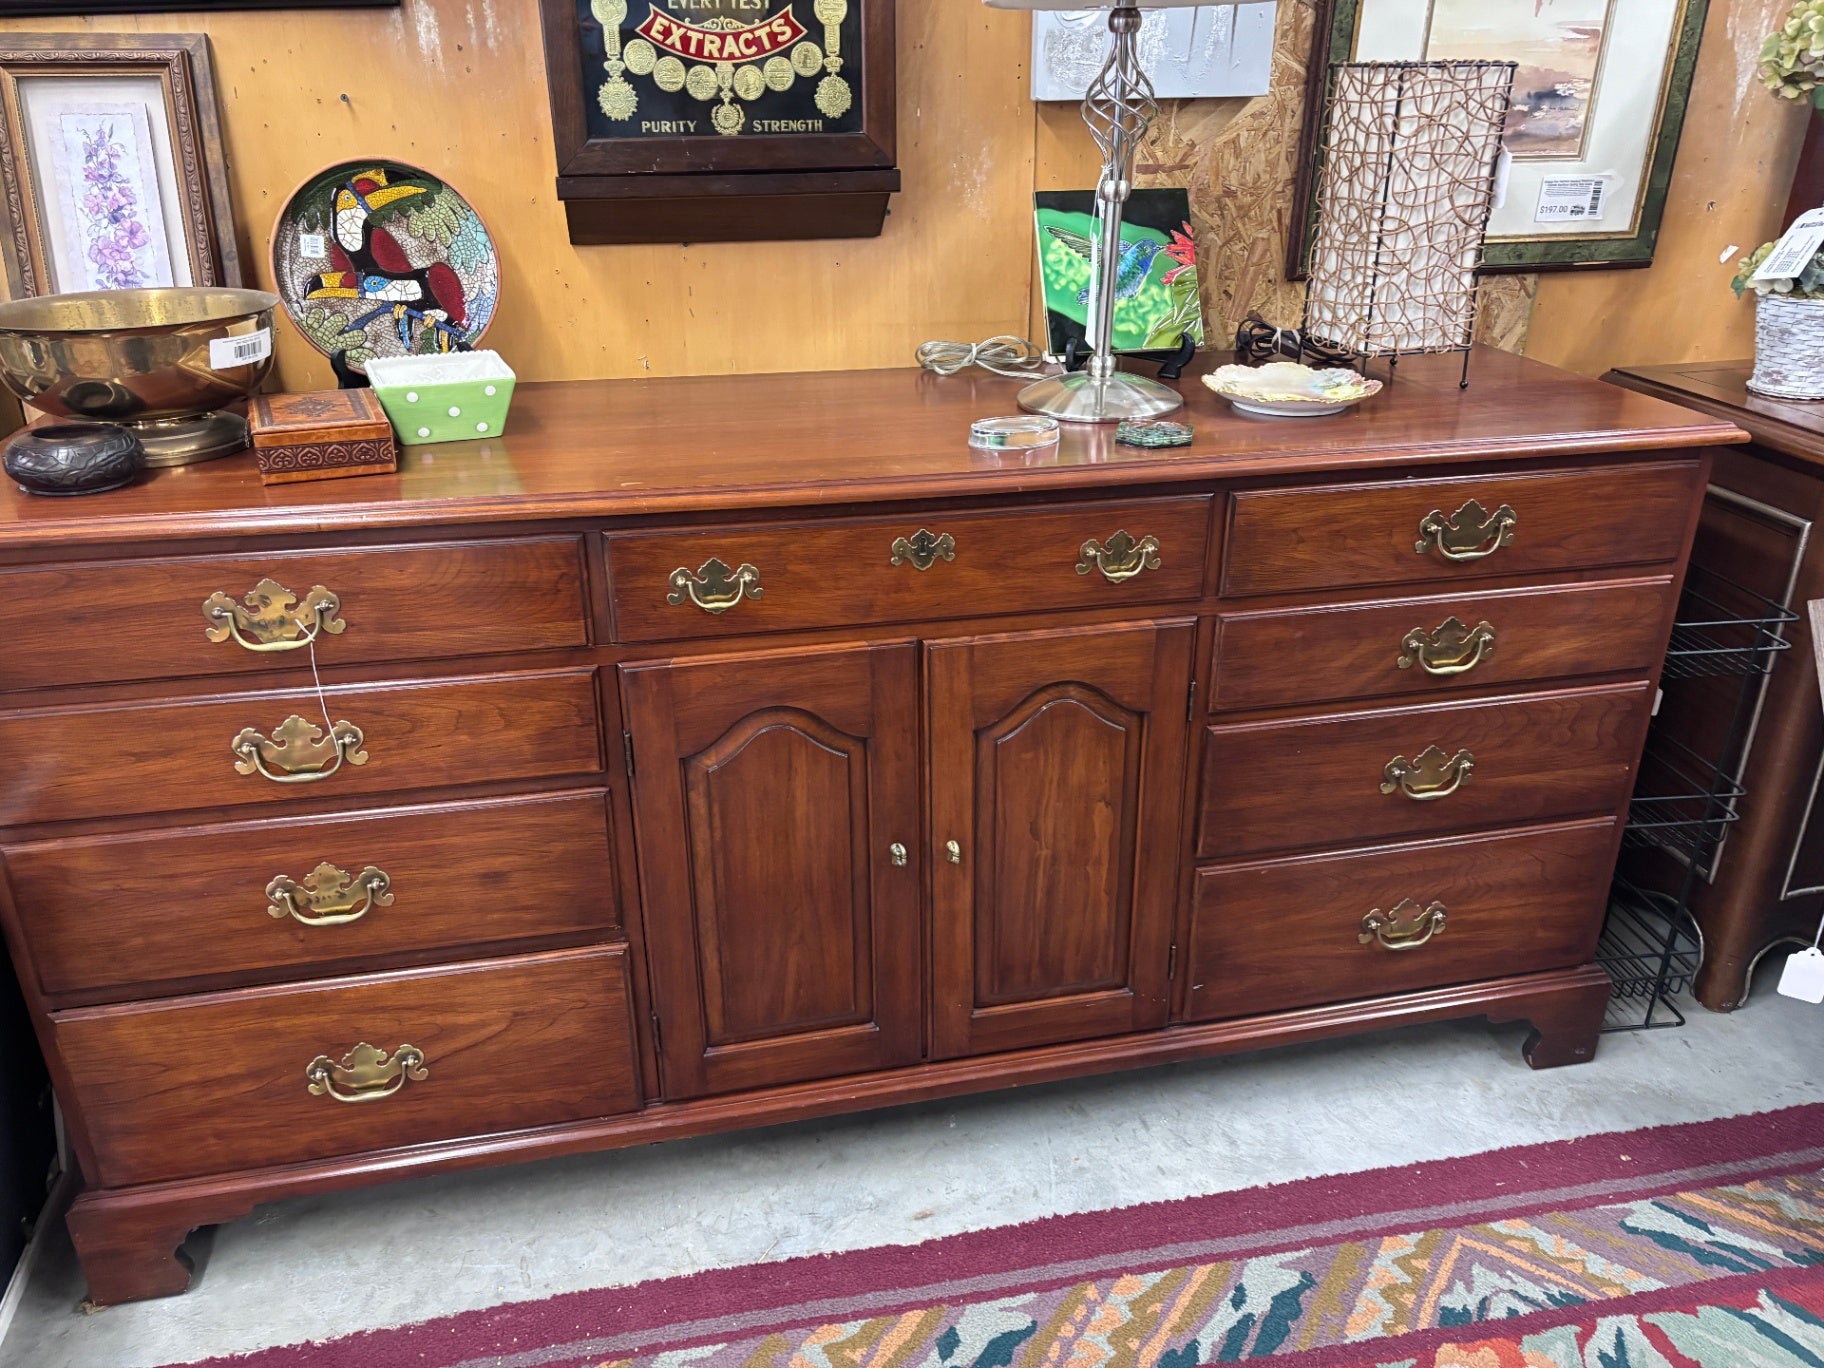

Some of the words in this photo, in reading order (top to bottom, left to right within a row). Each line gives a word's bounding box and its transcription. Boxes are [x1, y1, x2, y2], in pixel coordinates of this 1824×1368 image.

[650, 15, 793, 58] EXTRACTS
[641, 120, 697, 133] PURITY
[753, 119, 823, 132] STRENGTH
[1540, 205, 1569, 214] $197.00
